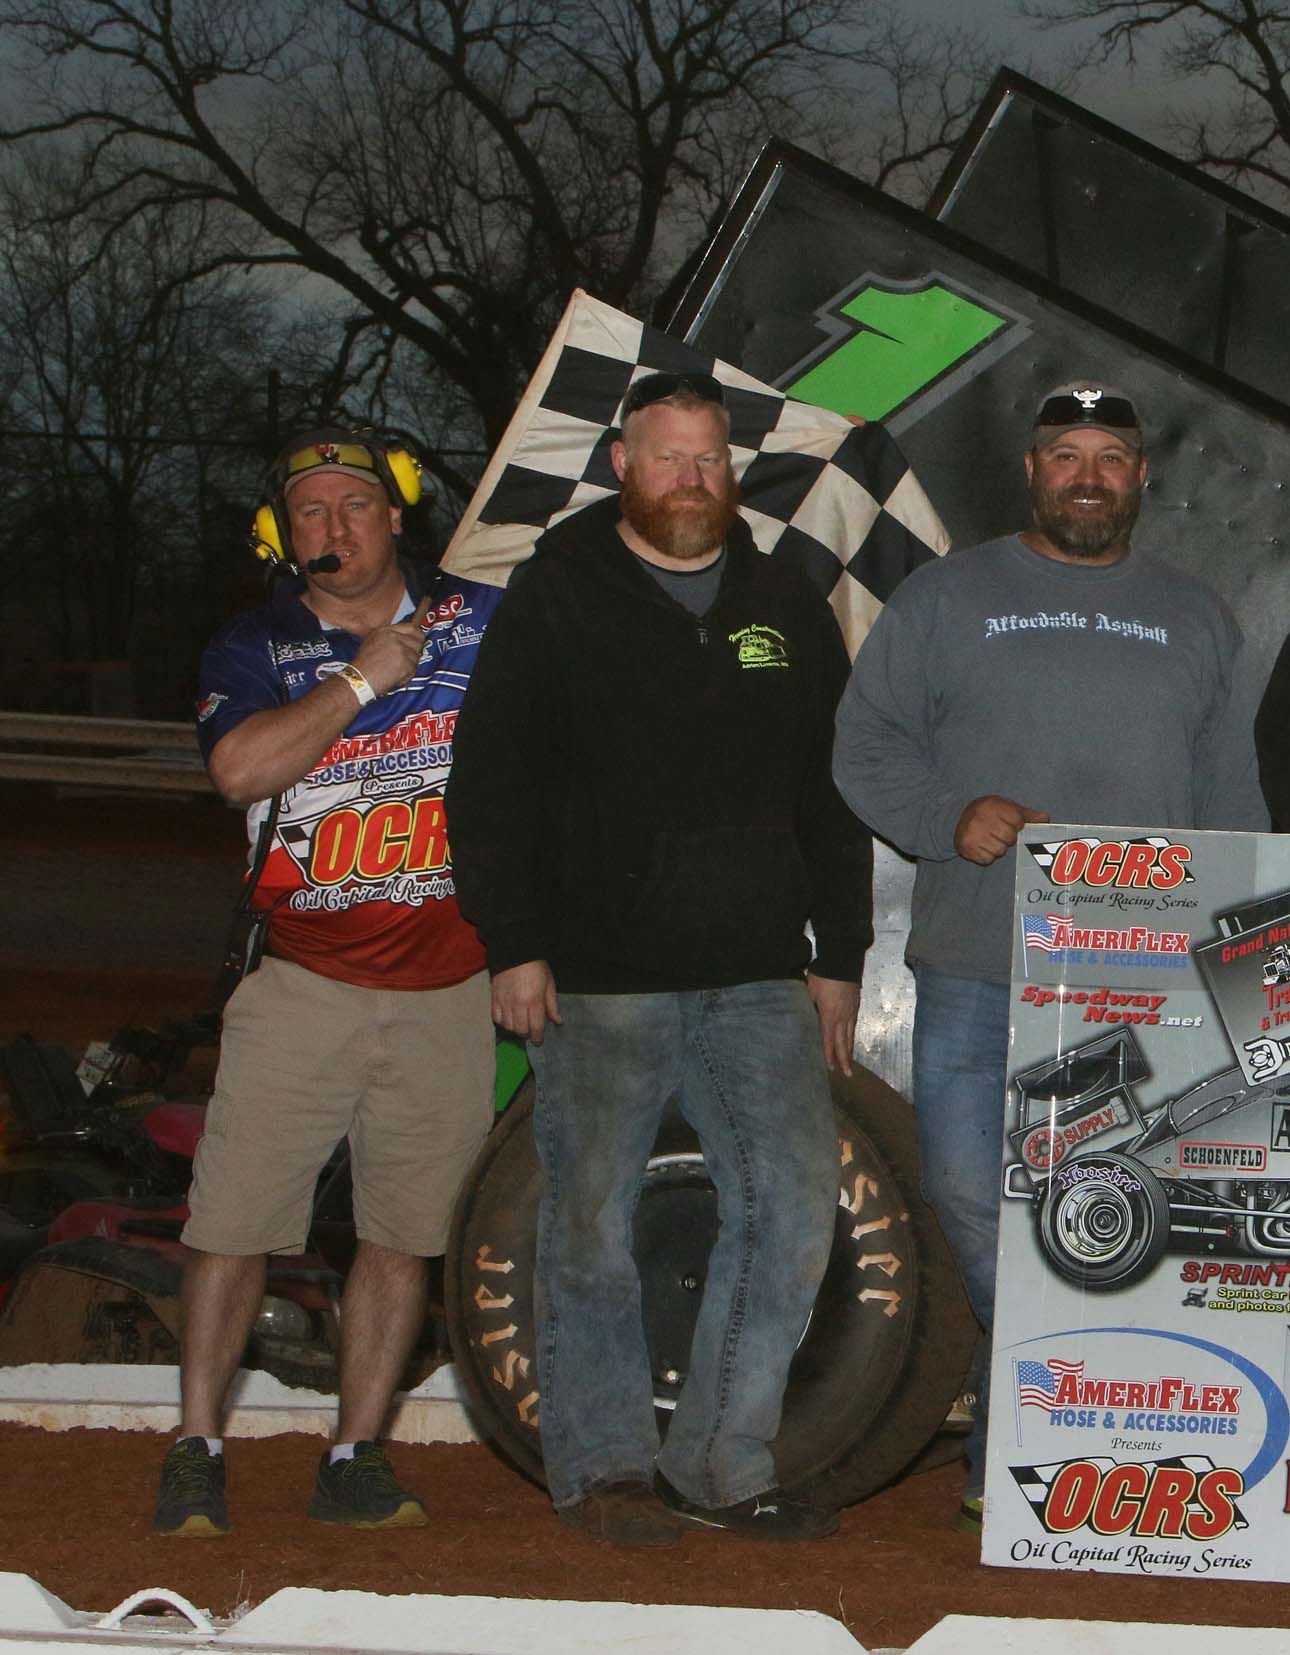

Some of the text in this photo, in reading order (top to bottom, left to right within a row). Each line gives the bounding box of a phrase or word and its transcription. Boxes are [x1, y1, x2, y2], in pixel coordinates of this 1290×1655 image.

[775, 273, 1024, 428] 1
[985, 612, 1168, 644] Affordable Asphalt
[358, 761, 370, 777] &
[364, 777, 419, 794] Presents
[311, 797, 452, 884] OCR
[1051, 839, 1192, 889] OCRS
[291, 888, 322, 910] Oil
[325, 881, 391, 910] Capital
[1028, 889, 1199, 910] Oil Capital Racing Series
[1049, 952, 1084, 966] HOSE
[1104, 953, 1189, 969] ACCESSORIES
[1221, 933, 1264, 964] Grand
[1020, 986, 1168, 1011] Speedway
[1083, 1006, 1203, 1028] News.net
[1260, 1016, 1271, 1030] &
[1064, 1107, 1114, 1145] SUPPLY
[1184, 1146, 1263, 1167] SCHOENFELD
[1058, 1164, 1142, 1192] Hoosier
[1209, 1300, 1234, 1310] and
[1237, 1301, 1283, 1312] photos
[1217, 1287, 1259, 1299] Sprint
[1262, 1289, 1287, 1300] Car
[1050, 1410, 1237, 1435] HOSE & ACCESSORIES
[1111, 1438, 1162, 1452] Presents
[1045, 1460, 1244, 1541] OCRS
[1010, 1538, 1252, 1574] Oil Capital Racing Series
